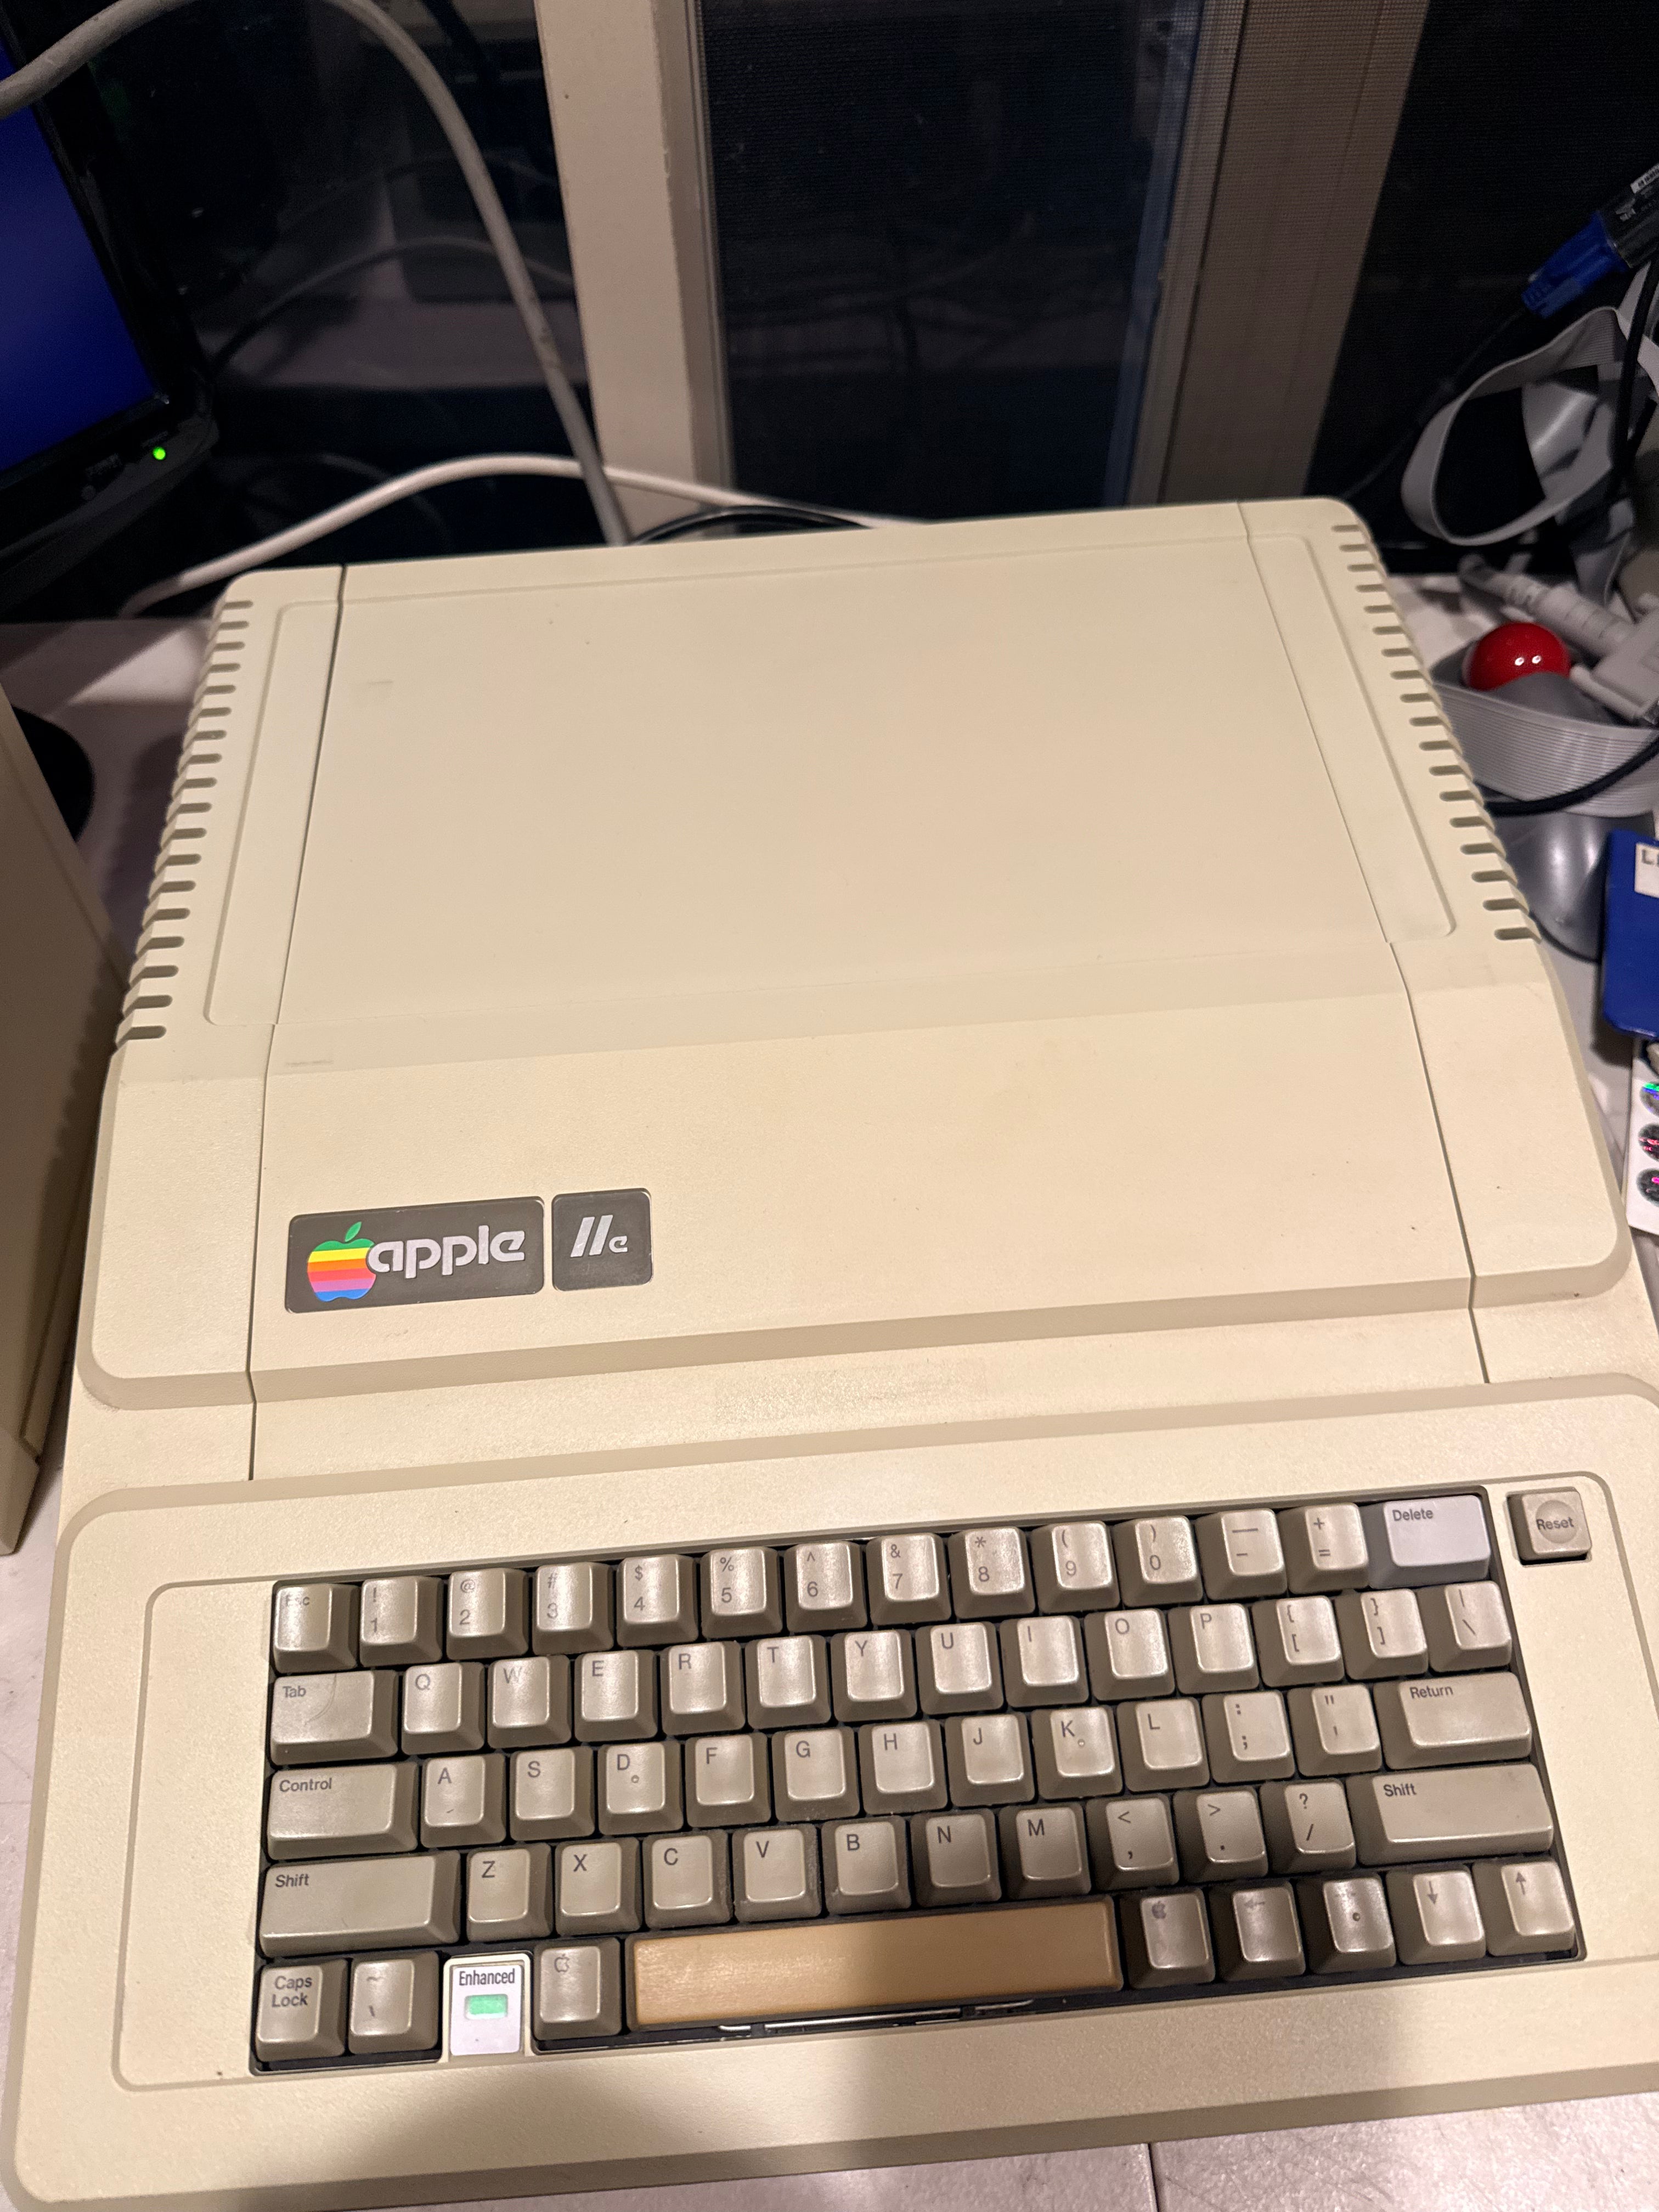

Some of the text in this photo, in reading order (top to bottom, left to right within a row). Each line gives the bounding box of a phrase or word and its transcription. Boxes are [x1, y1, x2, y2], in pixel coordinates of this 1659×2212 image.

[368, 1225, 525, 1279] apple
[1314, 1518, 1324, 1529] +
[1392, 1509, 1434, 1521] Delete
[1536, 1517, 1575, 1530] Reset
[1062, 1530, 1068, 1548] (
[1150, 1525, 1156, 1543] )
[890, 1544, 901, 1558] &
[720, 1557, 734, 1572] %
[1065, 1560, 1076, 1577] 9
[1149, 1554, 1161, 1570] 0
[548, 1572, 557, 1589] #
[635, 1565, 643, 1581] $
[893, 1573, 903, 1589] 7
[978, 1566, 990, 1582] 8
[373, 1587, 377, 1602] !
[460, 1578, 476, 1594] @
[807, 1581, 819, 1597] 6
[634, 1596, 645, 1611] 4
[721, 1587, 732, 1603] 5
[546, 1602, 558, 1619] 3
[1370, 1598, 1378, 1616] }
[370, 1618, 377, 1633] 1
[459, 1609, 471, 1625] 2
[1200, 1613, 1212, 1629] P
[1028, 1626, 1031, 1642] I
[1115, 1618, 1130, 1634] O
[941, 1633, 954, 1650] U
[1292, 1634, 1299, 1652] [
[1378, 1627, 1385, 1645] ]
[768, 1646, 779, 1663] T
[855, 1640, 867, 1657] Y
[592, 1660, 604, 1677] E
[679, 1654, 691, 1670] R
[415, 1674, 431, 1691] Q
[503, 1666, 523, 1684] W
[283, 1685, 306, 1698] Tab
[1409, 1685, 1454, 1700] Return
[1235, 1703, 1241, 1715] :
[1061, 1720, 1075, 1737] K
[1148, 1713, 1160, 1730] L
[884, 1733, 898, 1751] H
[973, 1728, 983, 1745] J
[1242, 1735, 1248, 1750] ;
[706, 1747, 718, 1764] F
[796, 1740, 811, 1758] G
[527, 1760, 541, 1778] S
[617, 1754, 630, 1770] D
[438, 1767, 453, 1784] A
[279, 1778, 332, 1792] Control
[1383, 1783, 1417, 1797] Shift
[1299, 1792, 1308, 1809] ?
[1118, 1811, 1131, 1824] <
[1207, 1803, 1221, 1816] >
[937, 1825, 952, 1843] N
[1028, 1819, 1045, 1836] M
[1306, 1824, 1314, 1841] /
[756, 1841, 769, 1858] V
[847, 1833, 860, 1851] B
[573, 1854, 588, 1872] X
[664, 1847, 679, 1866] C
[482, 1860, 495, 1878] Z
[275, 1873, 309, 1888] Shift
[274, 1975, 313, 1991] Caps
[459, 1968, 515, 1987] Enhanced
[272, 1992, 309, 2008] Lock
